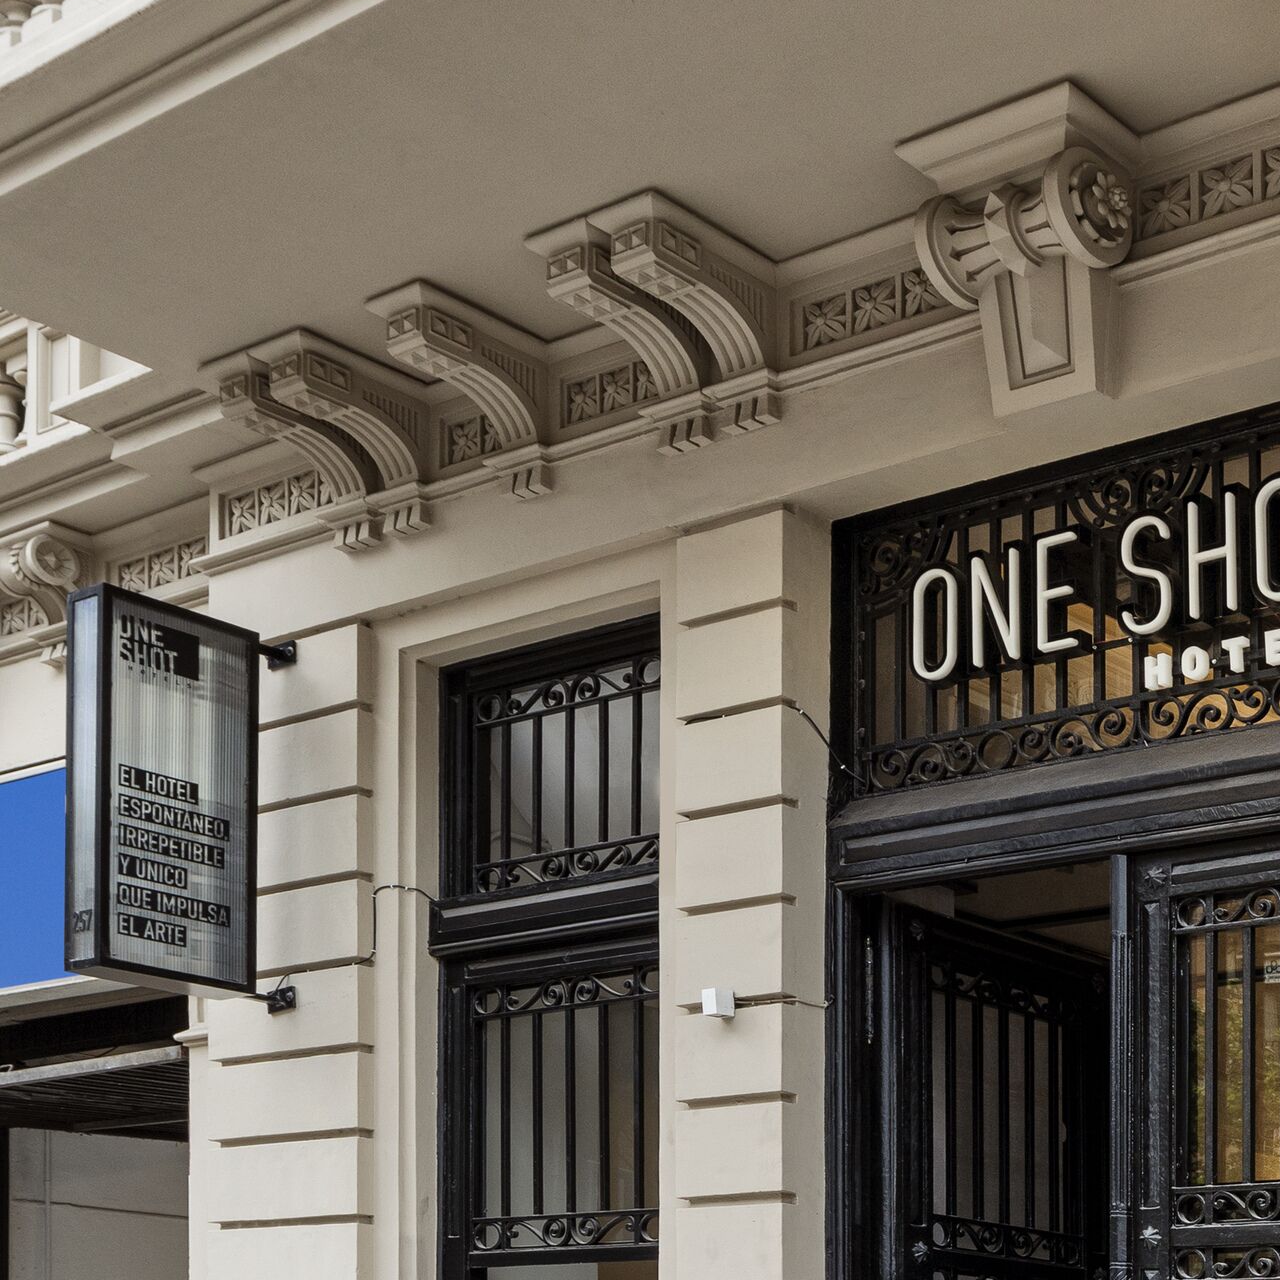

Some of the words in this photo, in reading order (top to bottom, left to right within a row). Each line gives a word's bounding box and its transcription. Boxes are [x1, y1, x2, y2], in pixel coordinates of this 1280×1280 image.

[912, 530, 1078, 682] ONE
[120, 614, 164, 648] ONE
[120, 638, 178, 674] SHOT
[120, 765, 140, 789] EL
[145, 772, 196, 803] HOTEL
[120, 825, 223, 868] IRREPETIBLE
[120, 856, 130, 875] Y
[119, 885, 152, 910] QUE
[157, 892, 228, 926] IMPULSA
[119, 915, 139, 937] EL
[143, 920, 185, 946] ARTE
